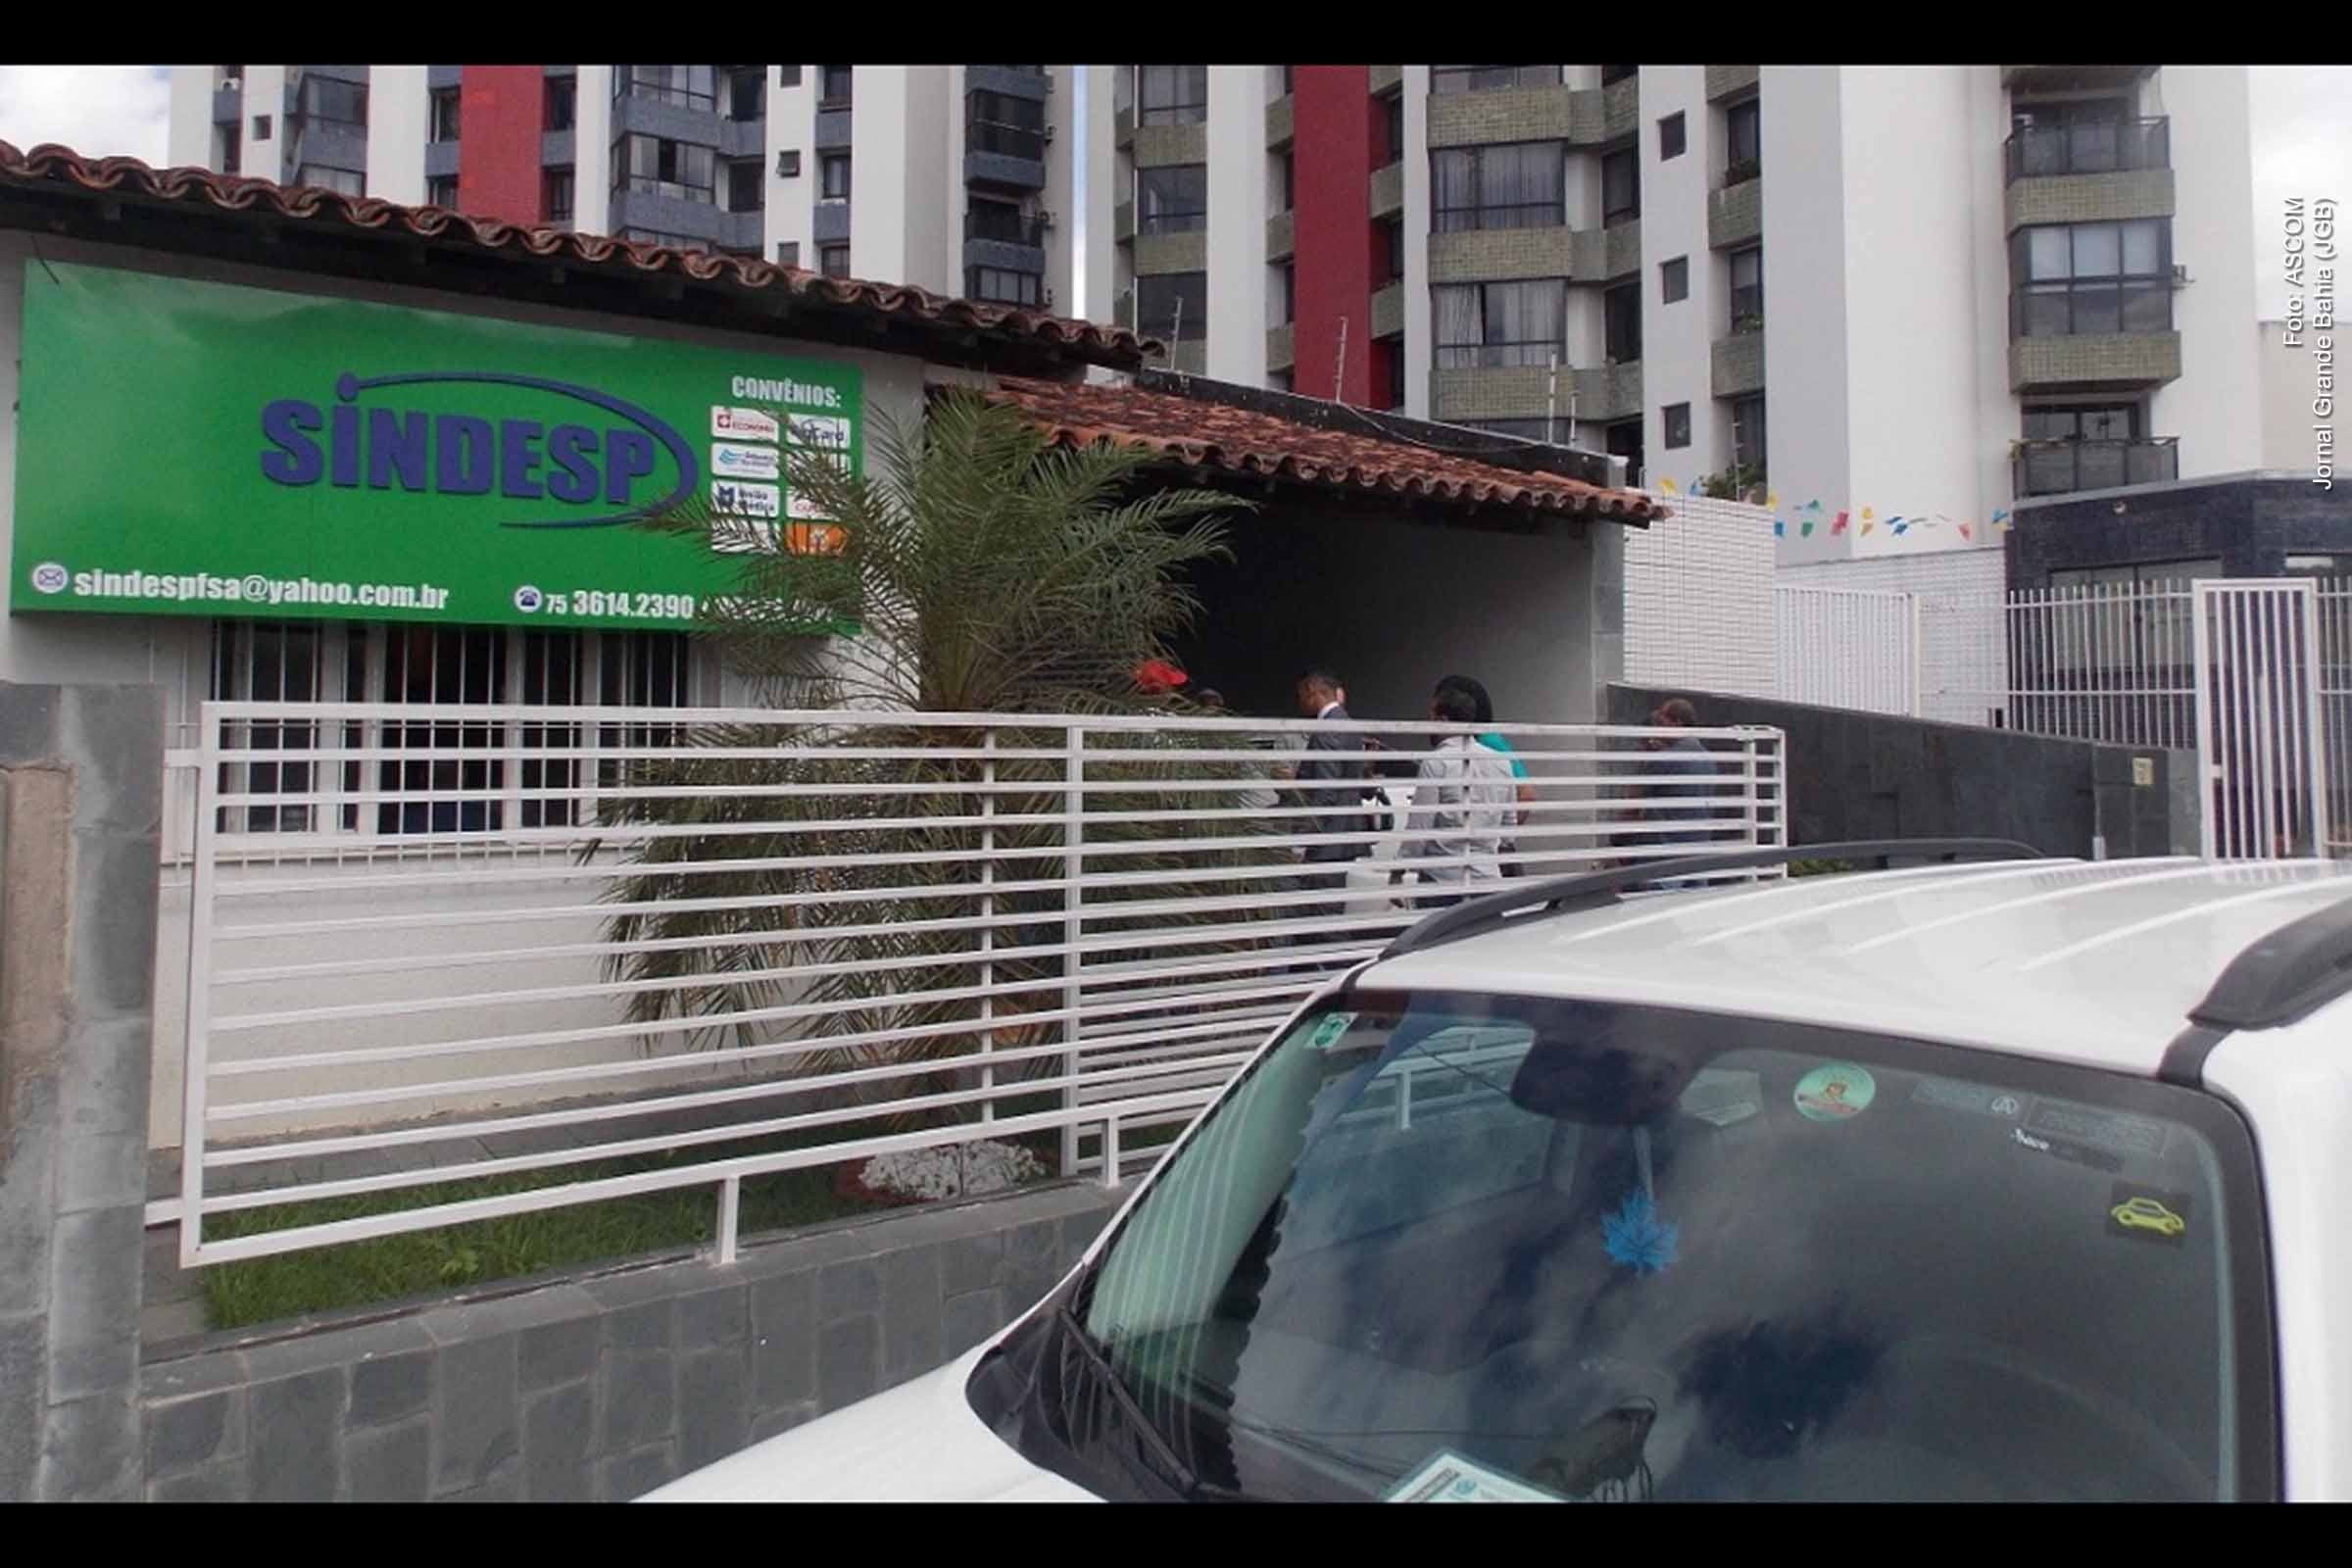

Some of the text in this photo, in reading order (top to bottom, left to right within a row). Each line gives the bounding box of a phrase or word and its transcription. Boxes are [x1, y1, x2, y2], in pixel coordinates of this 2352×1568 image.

[731, 374, 842, 409] CONVÊNIOS:
[74, 568, 449, 611] sindespfsa@yahoo.com.br
[546, 593, 568, 615] 75
[572, 589, 695, 620] 3614.2390
